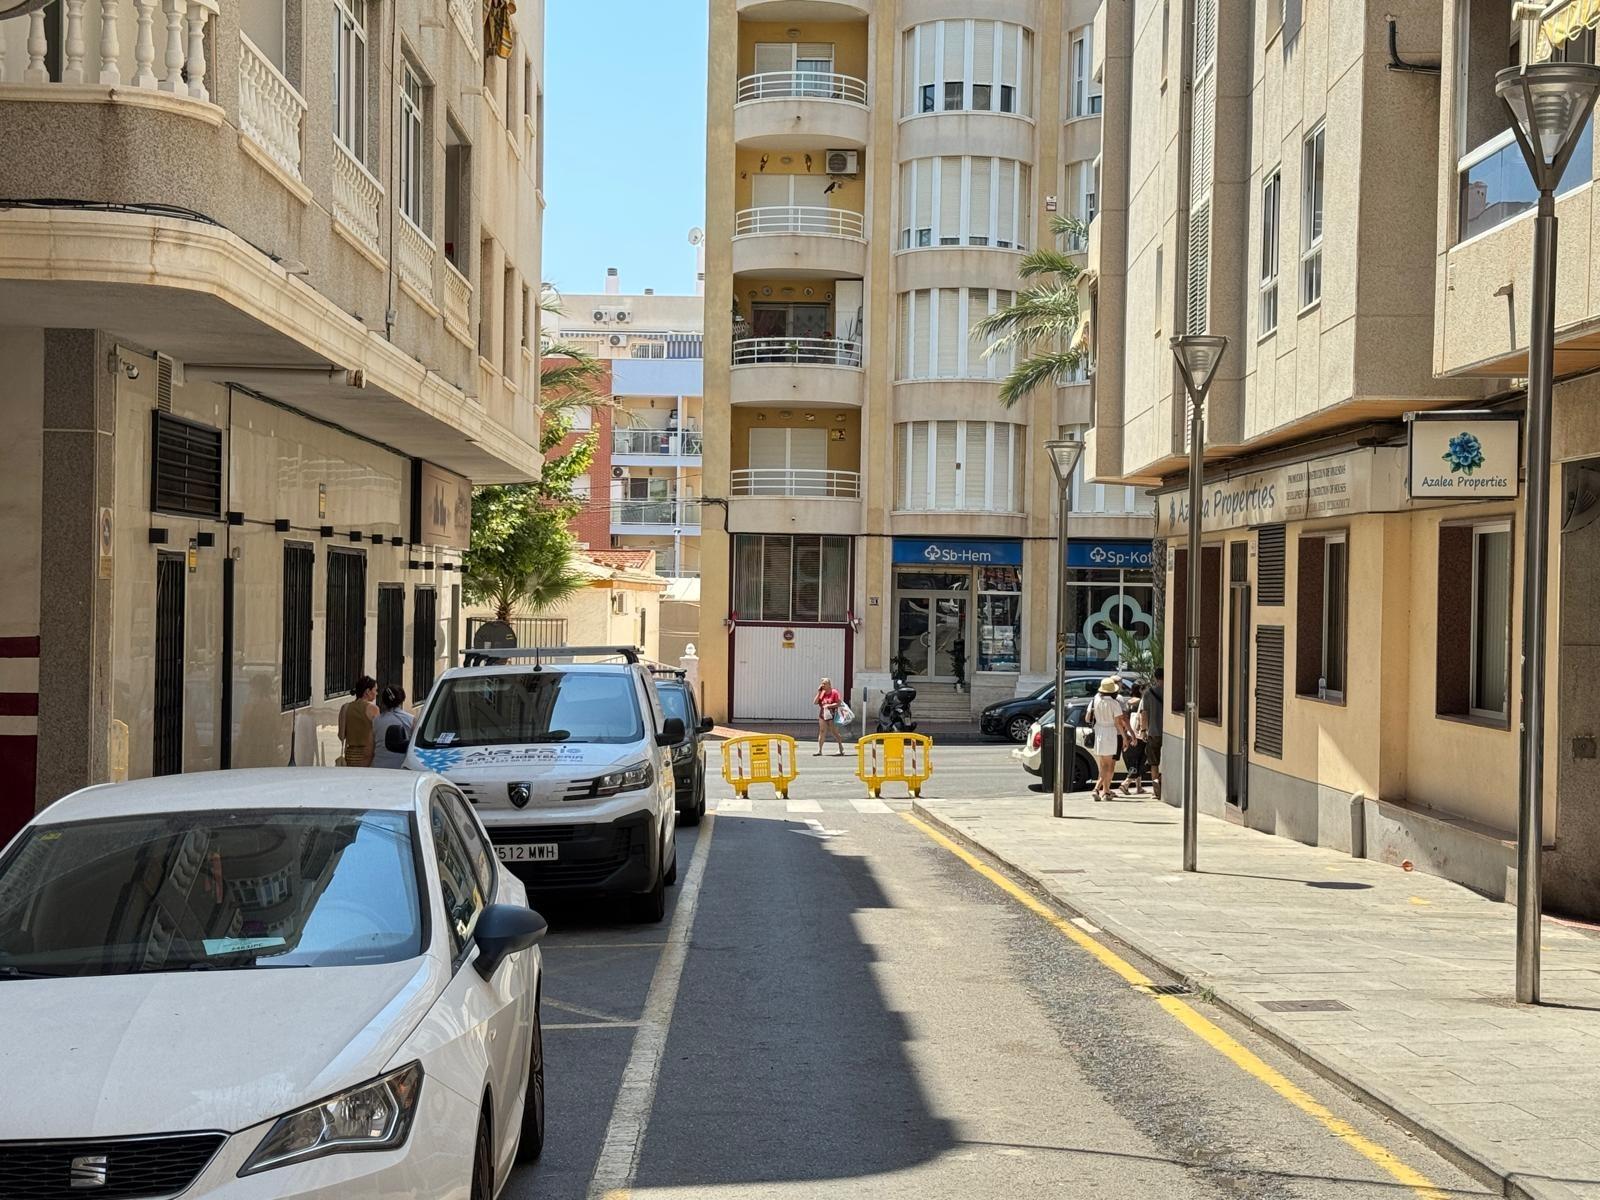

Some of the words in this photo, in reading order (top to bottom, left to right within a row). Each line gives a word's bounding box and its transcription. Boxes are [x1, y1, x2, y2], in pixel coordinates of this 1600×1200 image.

[1422, 475, 1454, 488] Azalea
[1457, 475, 1508, 492] Properties
[1178, 497, 1210, 523] Aza
[1213, 478, 1275, 526] Properties
[942, 549, 992, 562] Sb-Hem
[528, 845, 554, 859] MWH
